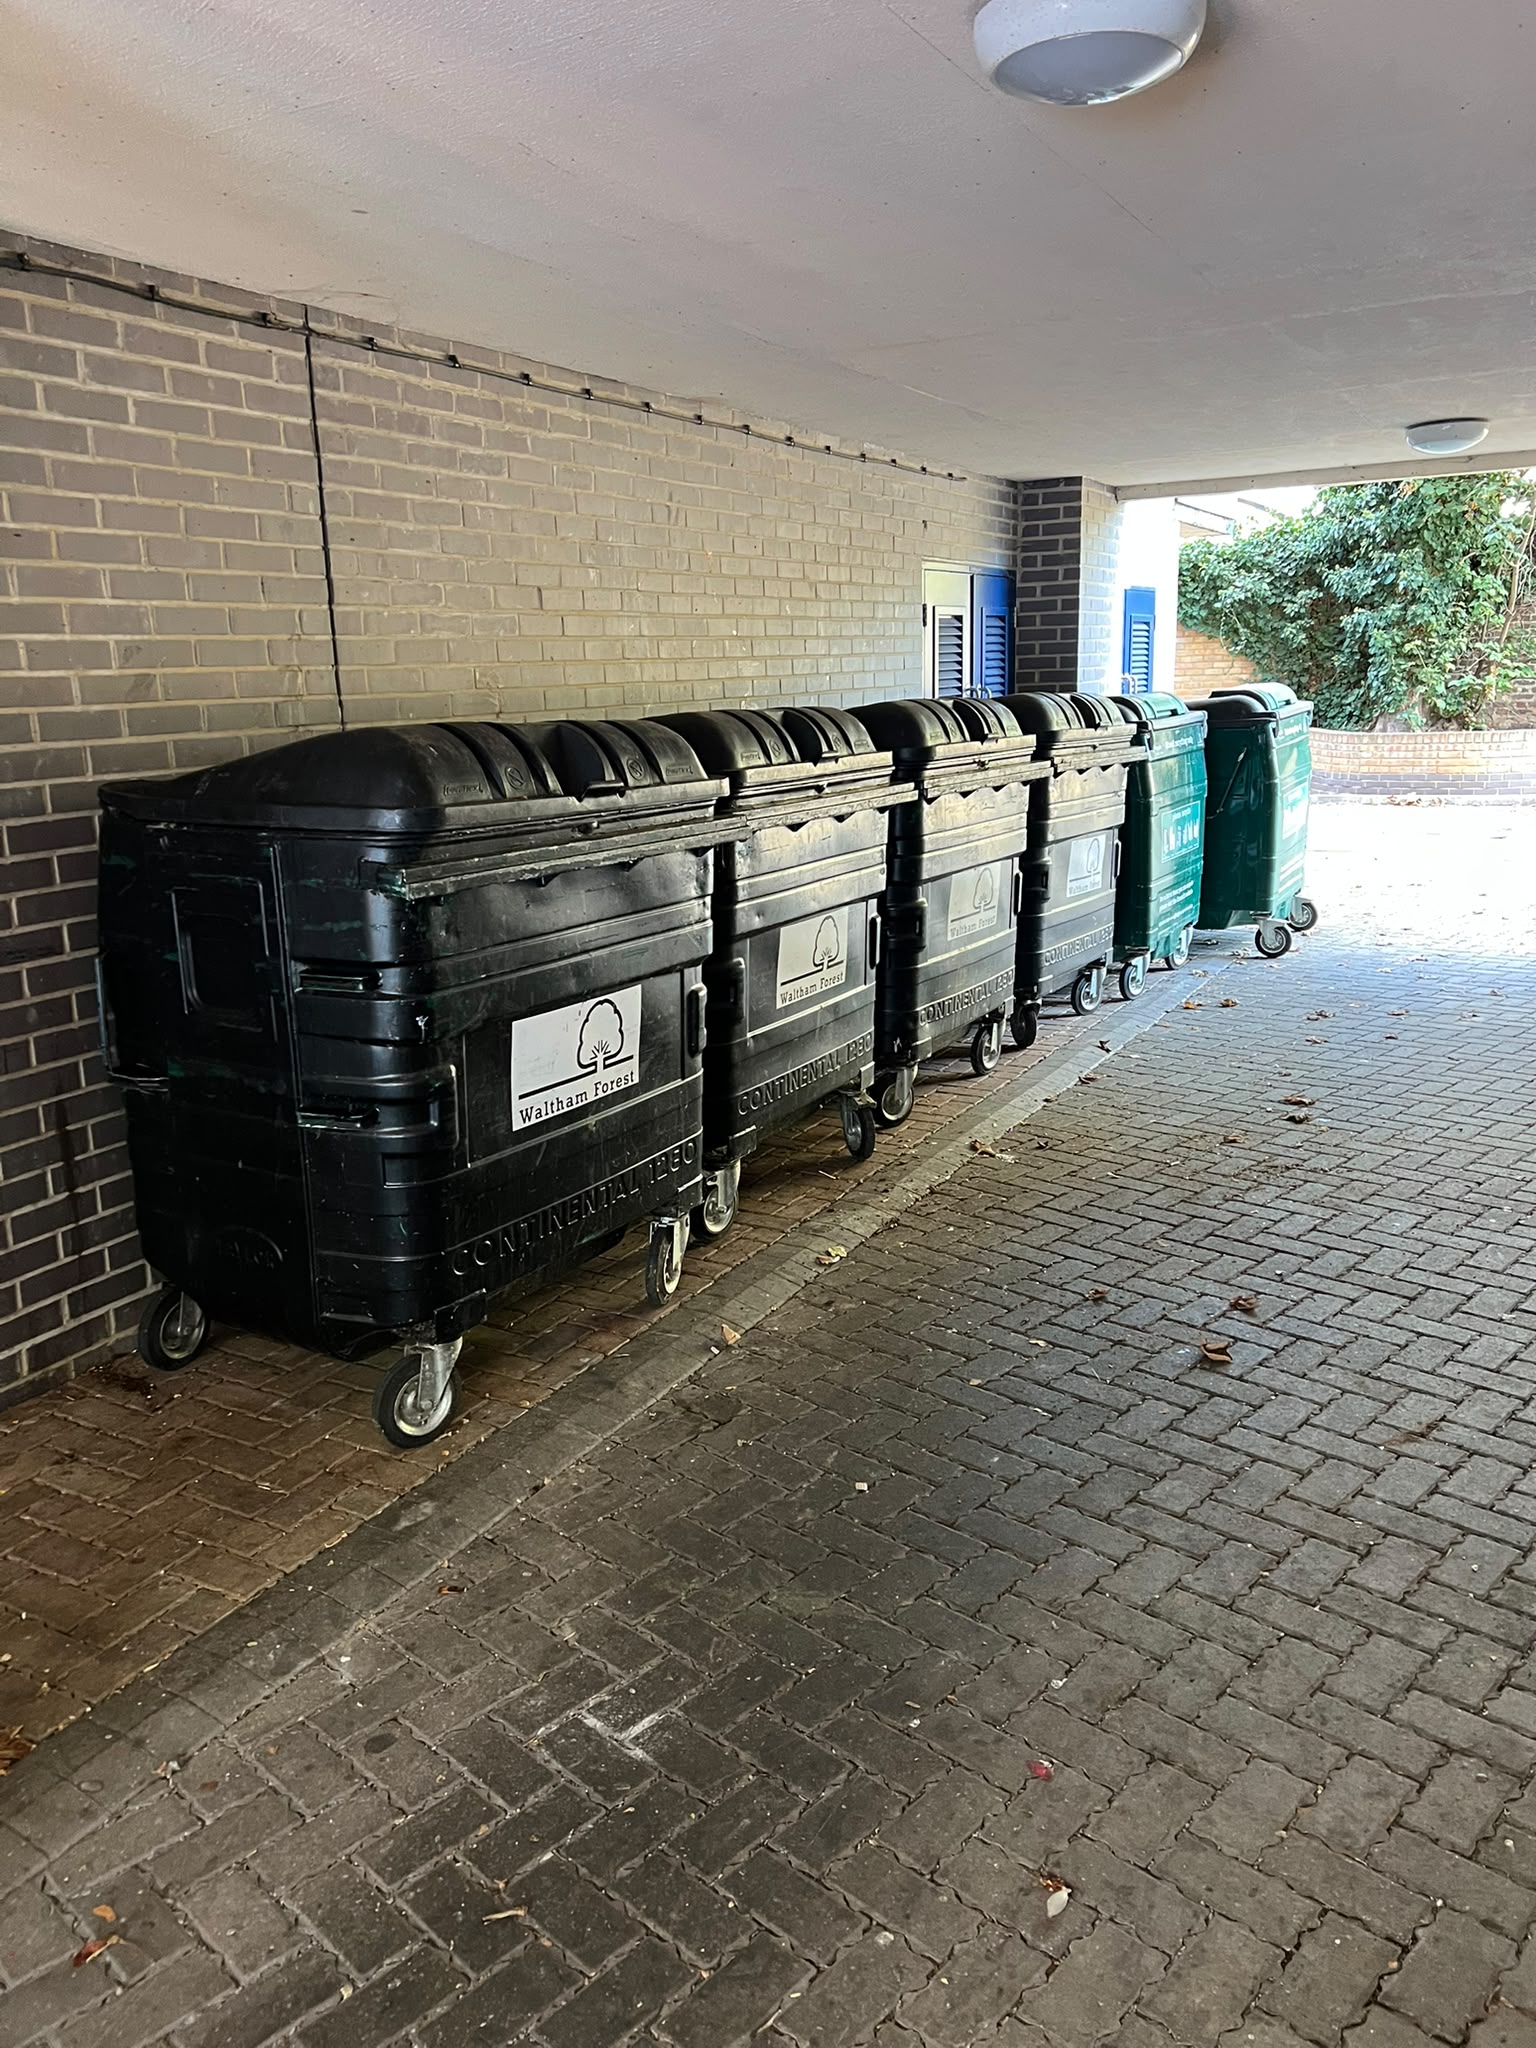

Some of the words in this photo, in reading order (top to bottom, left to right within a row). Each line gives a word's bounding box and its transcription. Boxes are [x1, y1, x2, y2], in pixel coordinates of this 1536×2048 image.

[780, 983, 817, 1005] Waltham
[820, 972, 844, 990] Forest
[919, 980, 992, 1026] CONTINENTAL
[519, 1091, 588, 1124] Waltham
[593, 1071, 635, 1097] Forest
[738, 1050, 841, 1115] CONTINENTAL
[845, 1032, 873, 1064] 1280
[452, 1169, 640, 1275] CONTINENTAL
[649, 1140, 696, 1184] 1280
